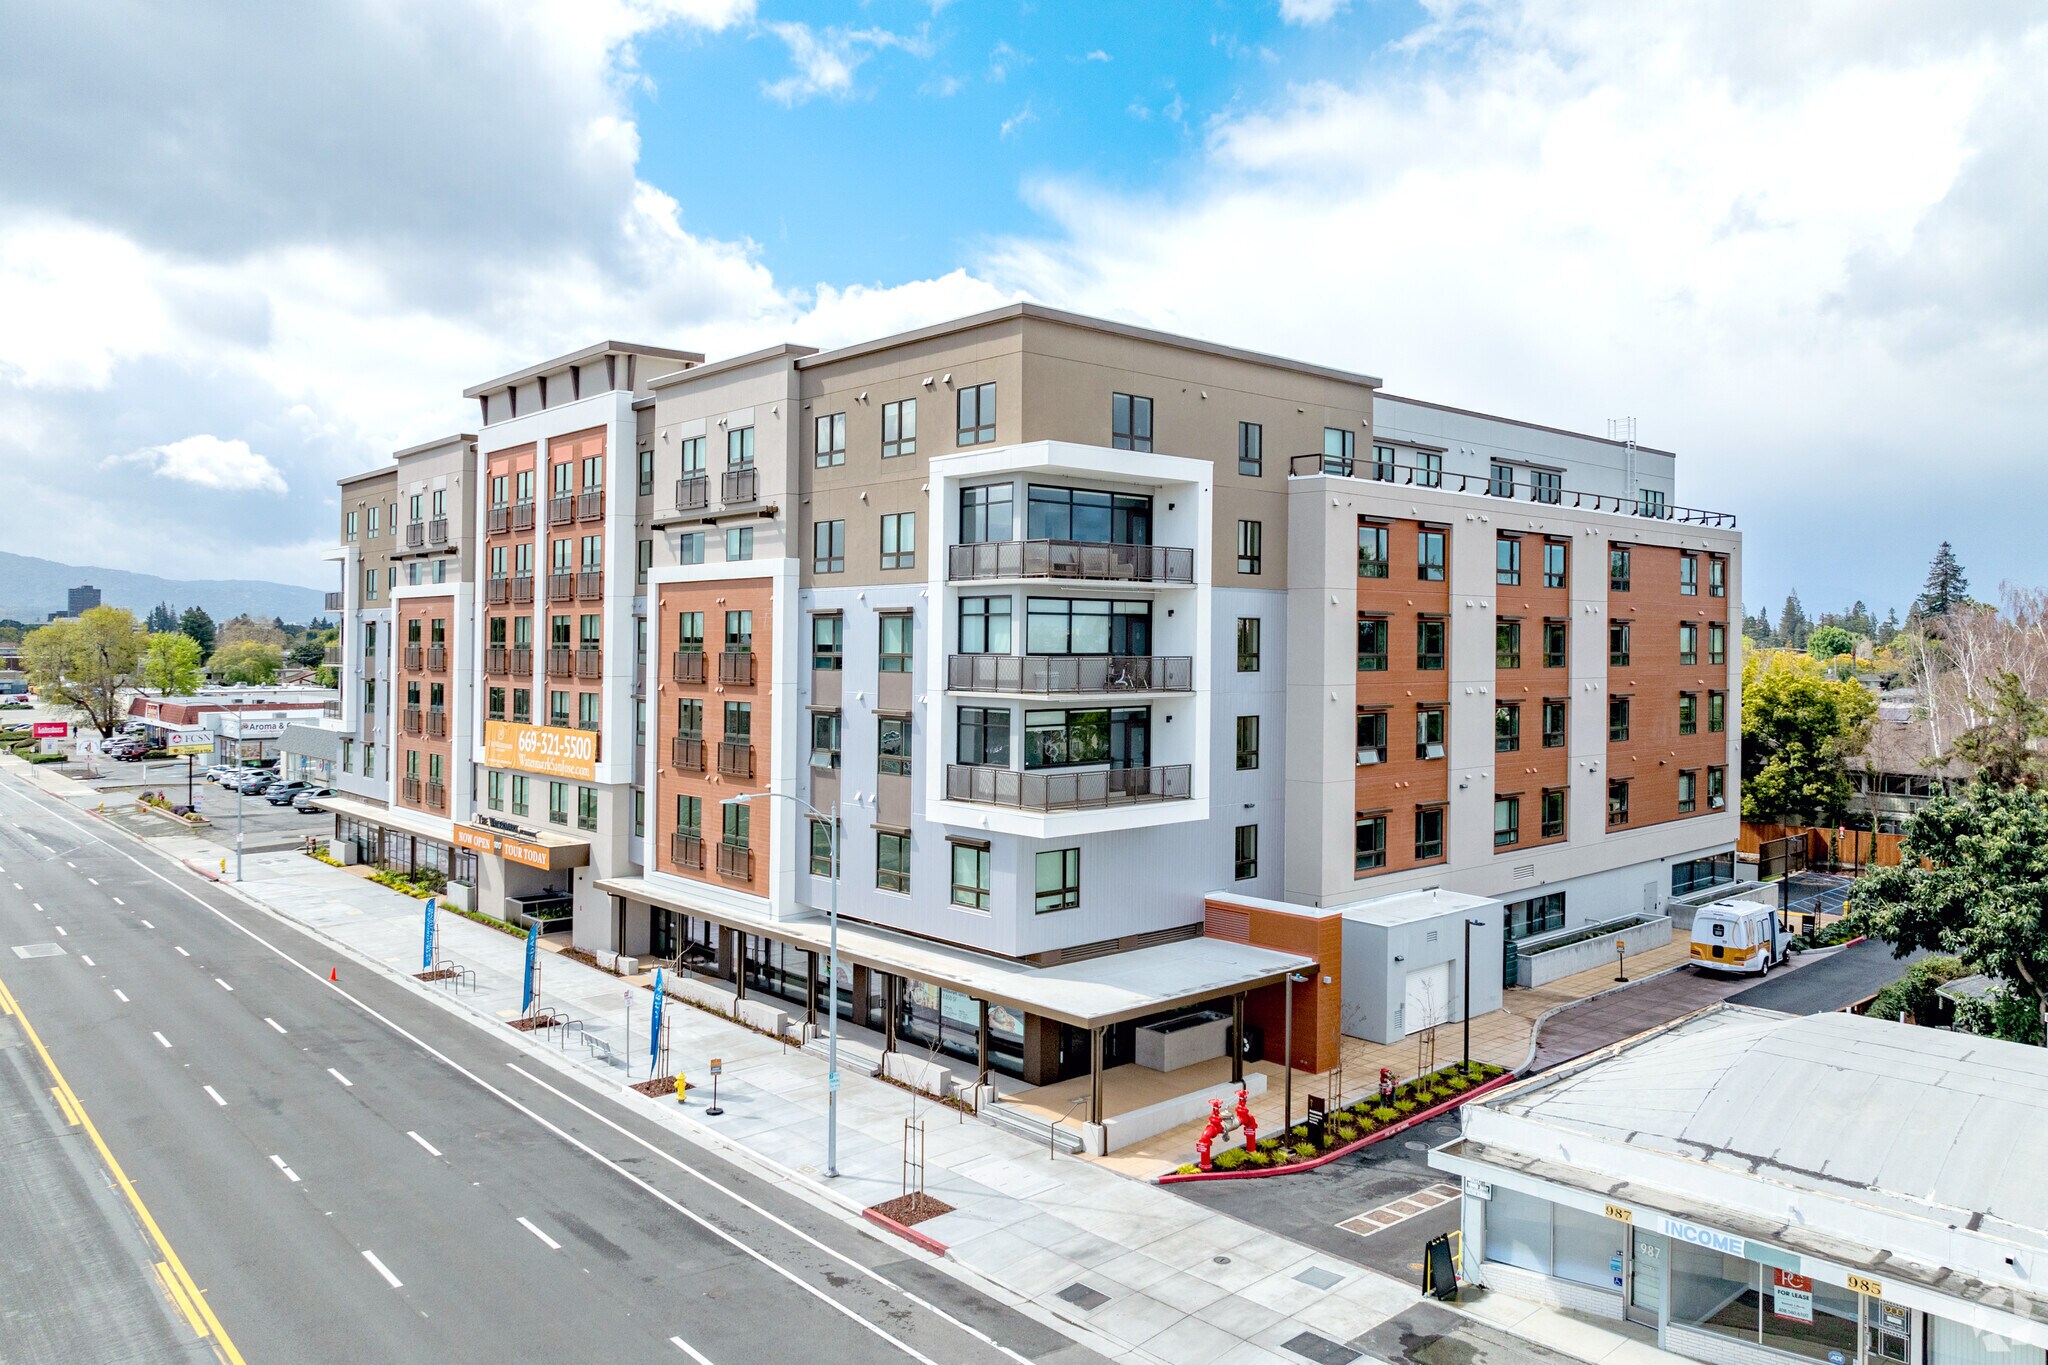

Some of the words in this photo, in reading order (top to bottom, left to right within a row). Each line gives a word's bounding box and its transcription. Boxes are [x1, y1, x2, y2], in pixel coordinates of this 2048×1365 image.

[185, 733, 211, 743] FCSN
[518, 730, 592, 760] 669-321-5500
[518, 753, 590, 776] WatermarkSanJose.com
[458, 832, 472, 844] NOW
[473, 836, 491, 849] OPEN
[504, 844, 523, 858] TOUR
[523, 848, 547, 865] TODAY
[1605, 1205, 1632, 1221] 987
[1665, 1219, 1743, 1254] INCOME
[1640, 1243, 1661, 1259] 987
[1848, 1276, 1881, 1295] 985
[1791, 1292, 1810, 1301] LEASE
